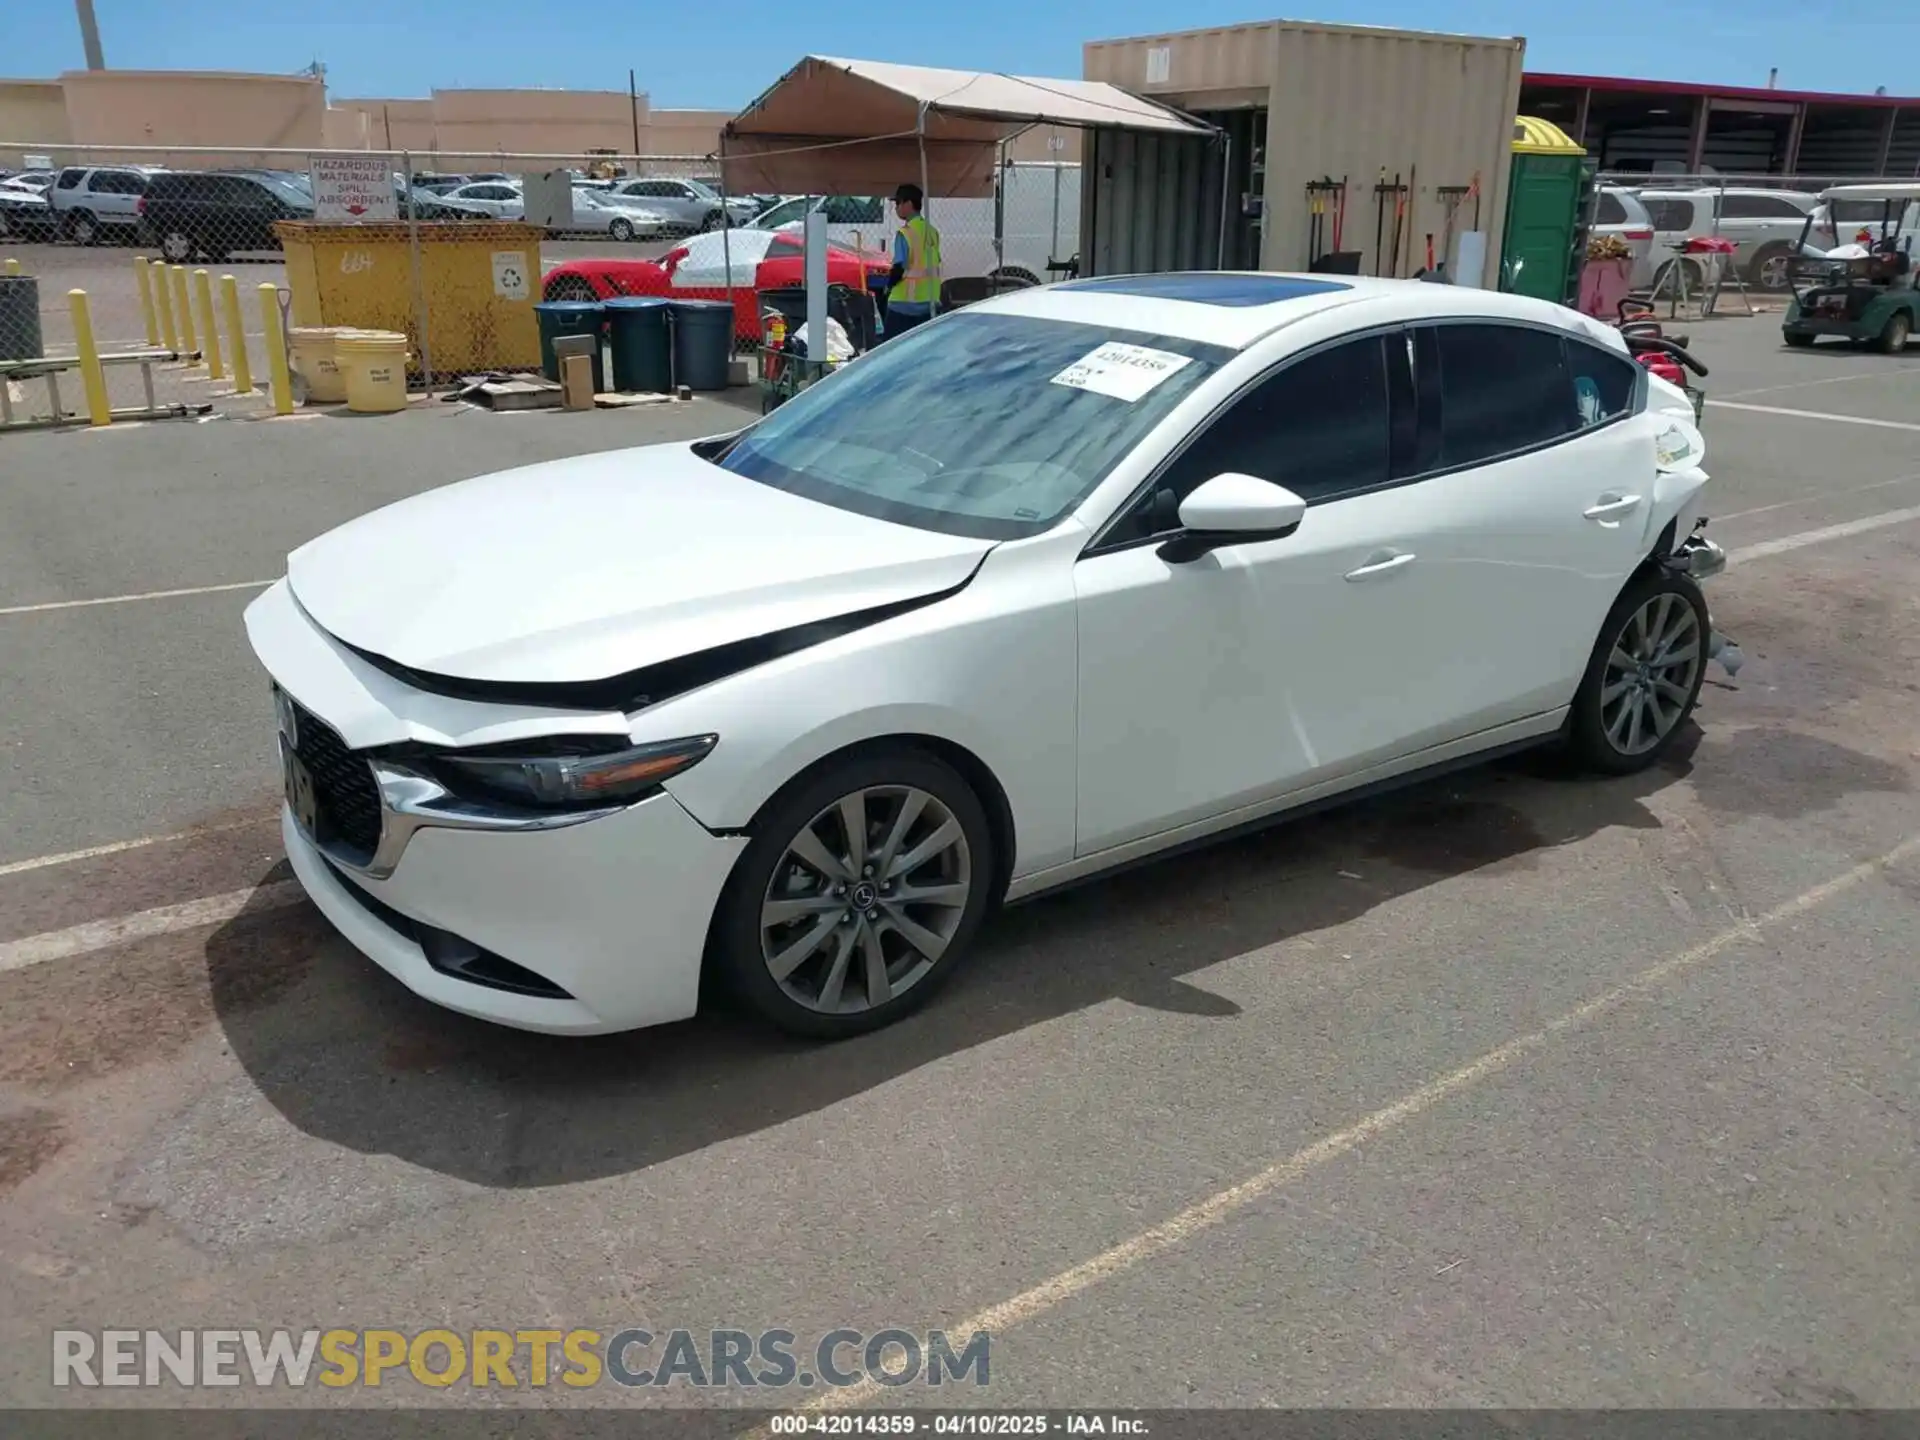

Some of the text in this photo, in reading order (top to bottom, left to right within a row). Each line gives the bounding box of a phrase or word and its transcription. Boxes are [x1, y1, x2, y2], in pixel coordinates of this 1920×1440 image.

[313, 160, 388, 171] HAZARDOUS
[318, 172, 386, 182] MATERIALS
[337, 183, 370, 193] SPILL
[318, 194, 391, 205] ABSORBENT
